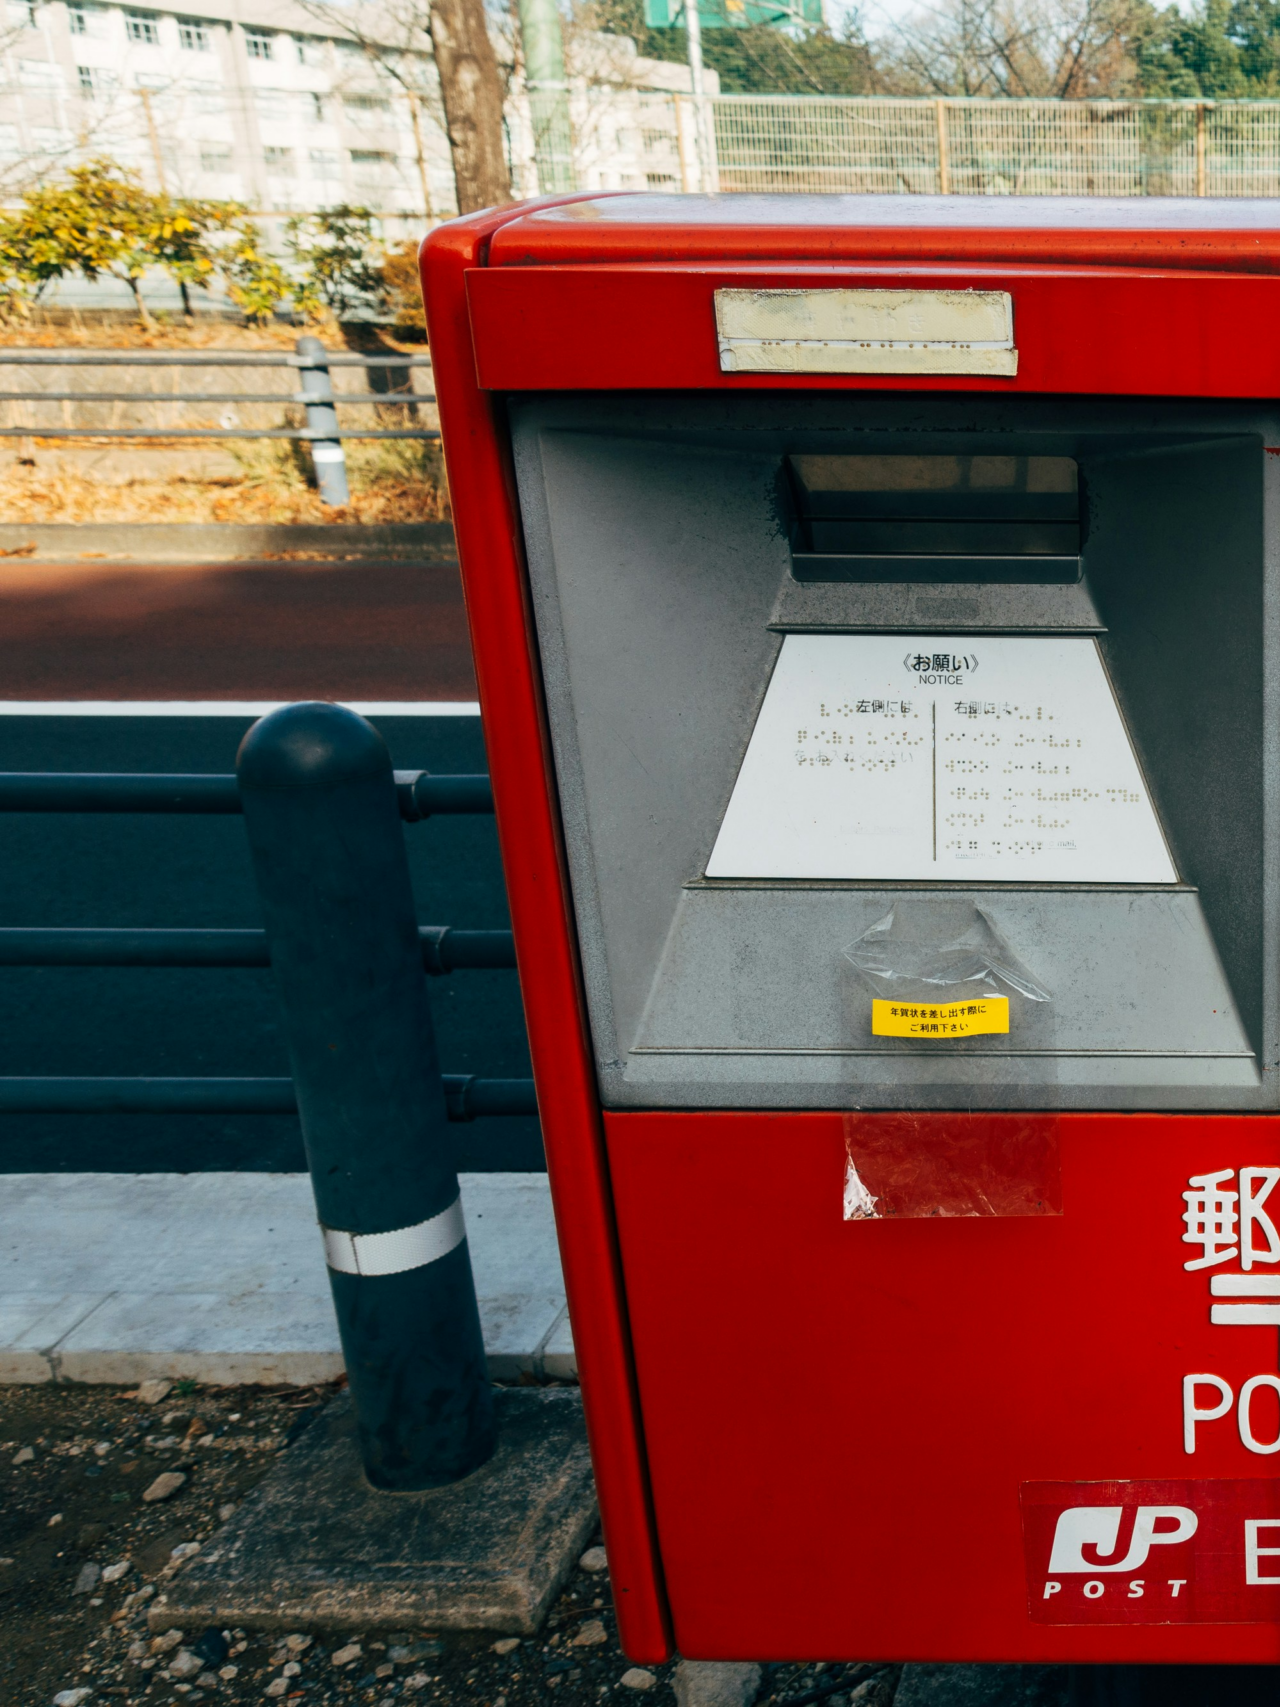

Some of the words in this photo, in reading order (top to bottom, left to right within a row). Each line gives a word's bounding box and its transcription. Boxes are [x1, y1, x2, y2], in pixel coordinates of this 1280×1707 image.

[919, 674, 963, 684] NOTICE
[890, 1004, 988, 1019] 年賀状を差し出す際に
[910, 1022, 969, 1032] ご利用下さい
[1043, 1578, 1188, 1600] POST
